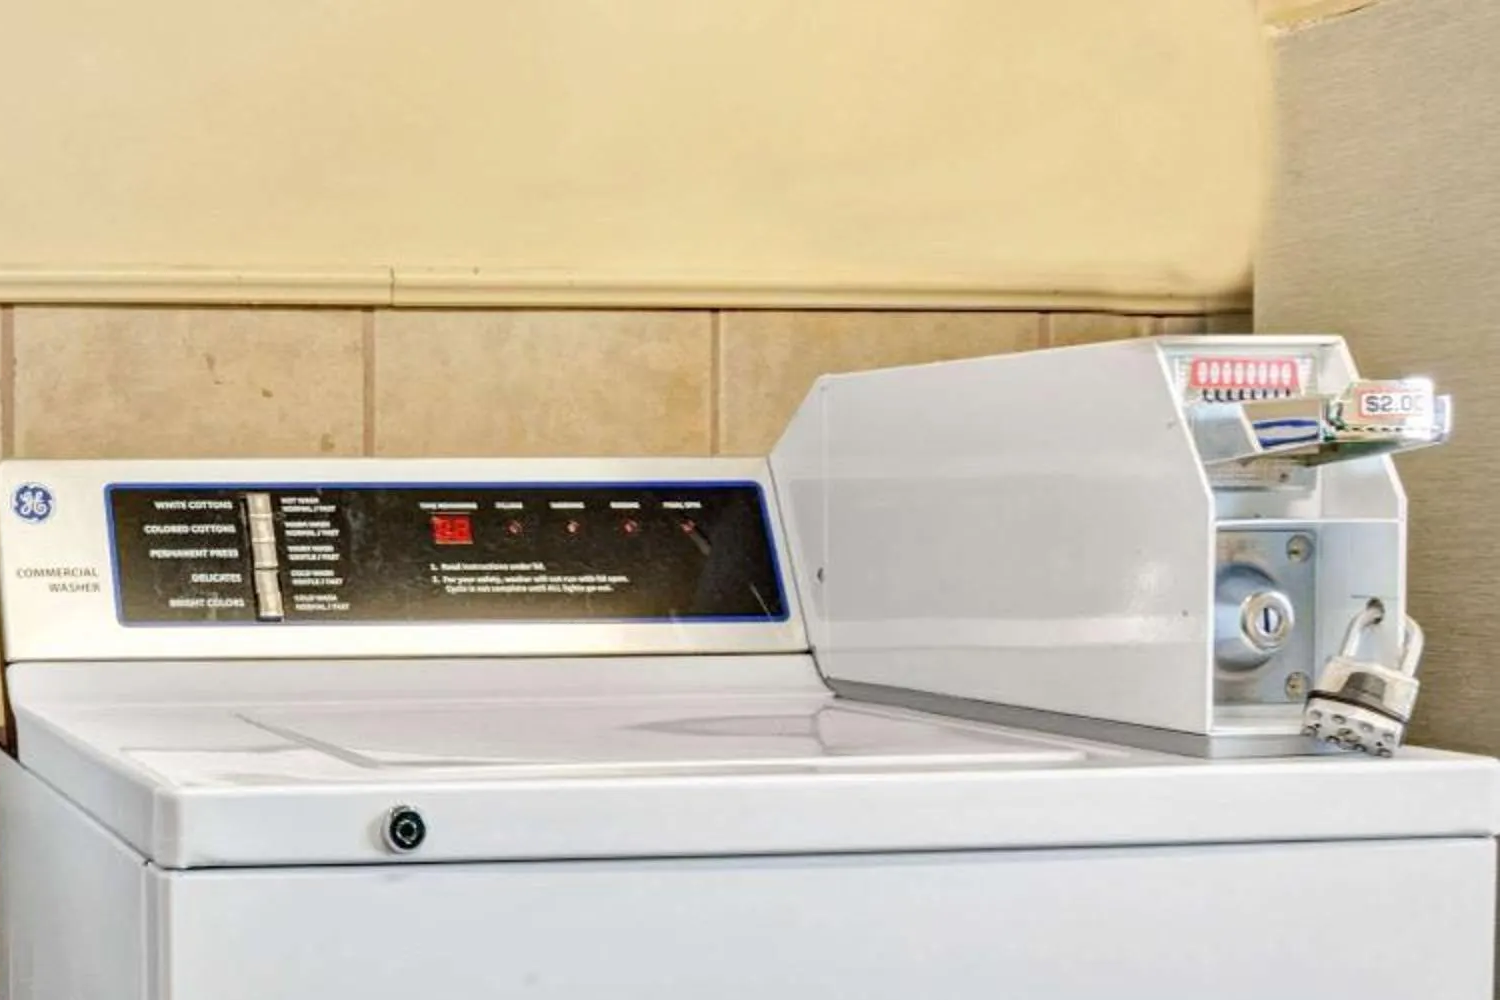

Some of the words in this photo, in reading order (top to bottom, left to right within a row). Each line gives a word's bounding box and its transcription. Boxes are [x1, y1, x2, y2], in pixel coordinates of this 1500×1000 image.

[15, 487, 52, 520] GE
[154, 500, 186, 510] WHITE
[187, 500, 233, 510] COTTONS
[143, 524, 190, 534] COLORED
[191, 524, 236, 534] COTTONS
[149, 549, 208, 559] PERMANENT
[208, 549, 239, 559] PRESS
[16, 567, 100, 578] COMMERCIAL
[191, 573, 243, 583] DELICATES
[48, 582, 100, 593] WASHER
[168, 598, 206, 608] BRIGHT
[206, 598, 245, 608] COLORS
